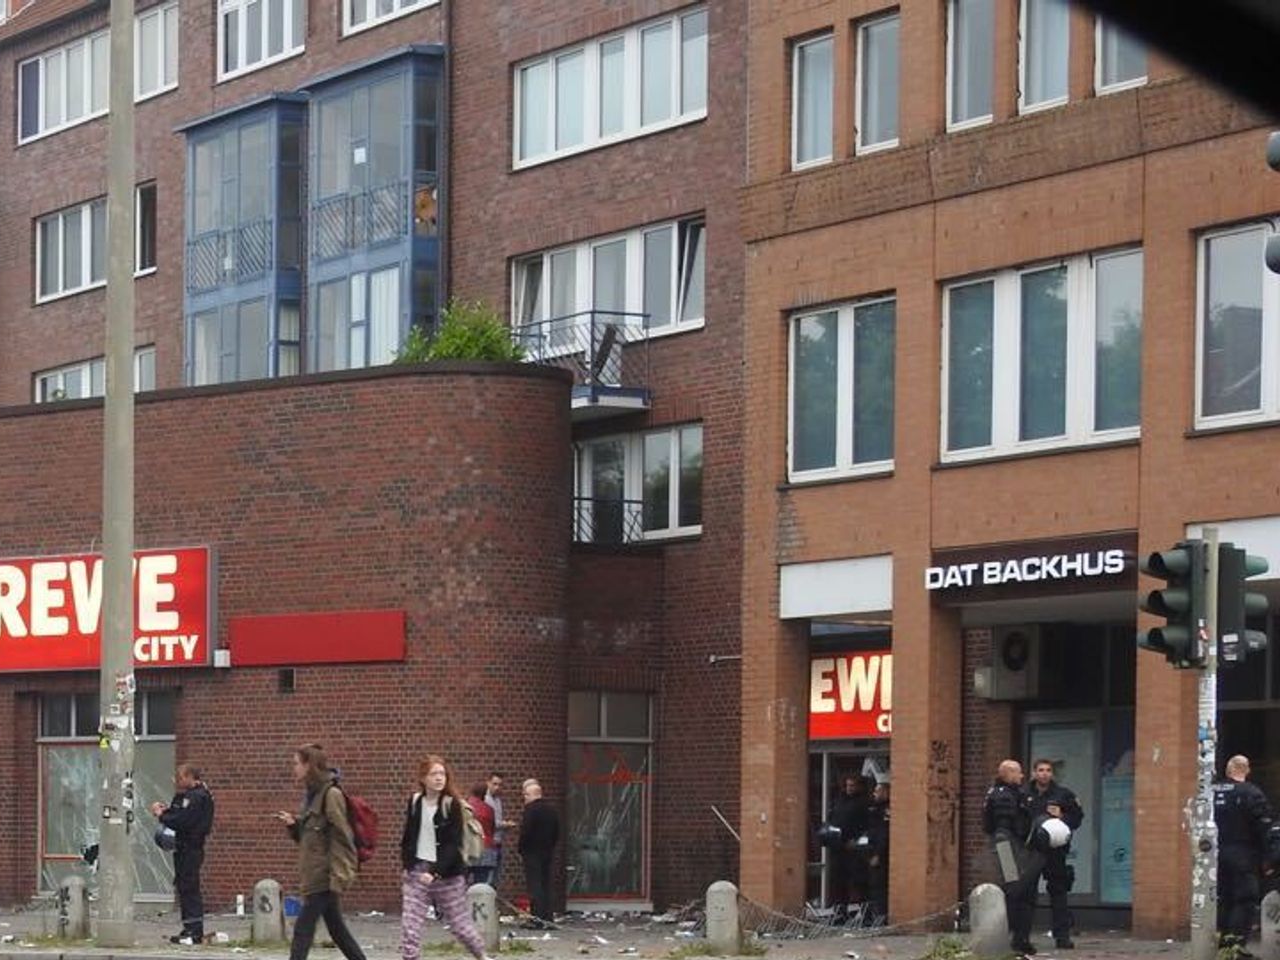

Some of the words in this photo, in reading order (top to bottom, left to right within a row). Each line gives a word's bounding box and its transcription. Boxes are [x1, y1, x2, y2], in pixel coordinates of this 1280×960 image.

[925, 563, 979, 590] DAT
[983, 549, 1125, 585] BACKHUS
[134, 634, 199, 662] CITY
